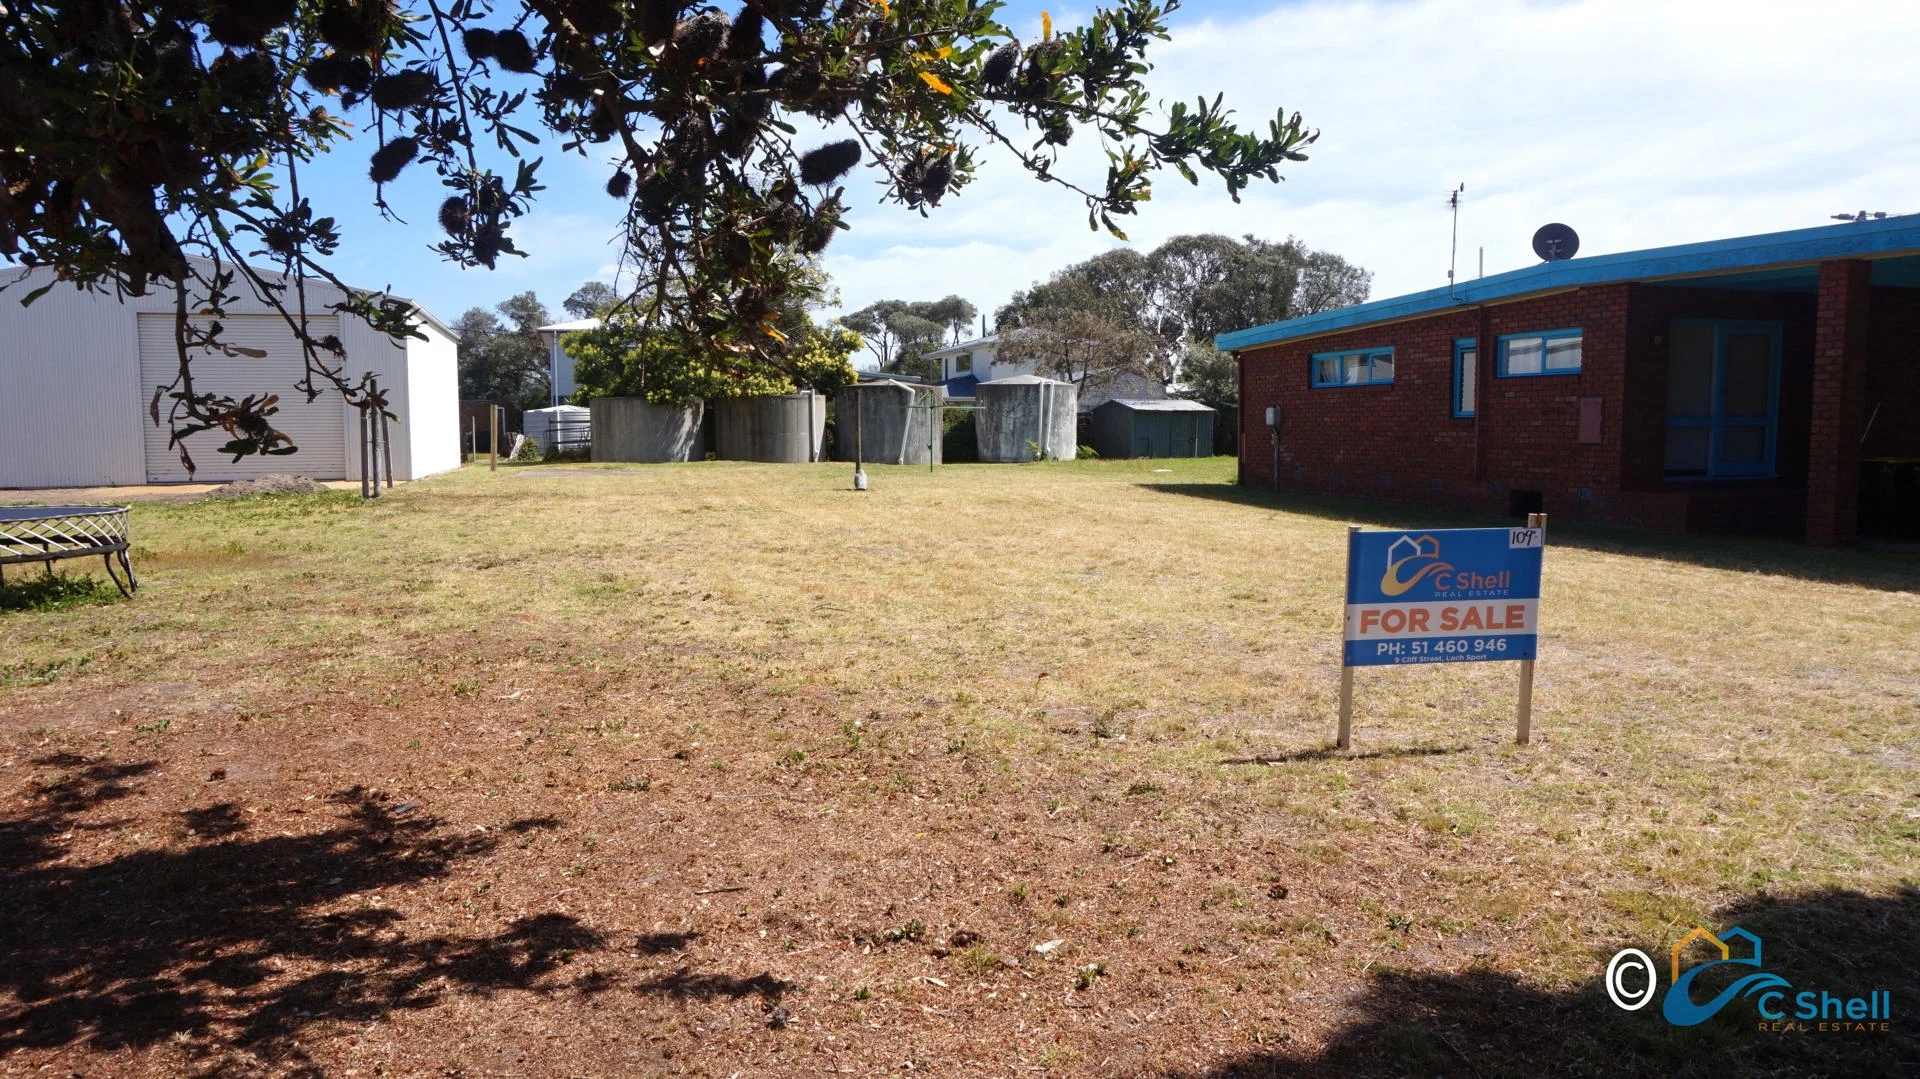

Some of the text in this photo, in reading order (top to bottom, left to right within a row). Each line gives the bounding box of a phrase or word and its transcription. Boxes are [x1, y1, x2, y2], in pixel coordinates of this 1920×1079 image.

[1435, 571, 1510, 590] C Shell
[1469, 589, 1510, 597] ESTATE
[1360, 605, 1525, 634] FOR SALE
[1377, 638, 1507, 656] PH: 51 460 946
[1466, 653, 1487, 662] Sport
